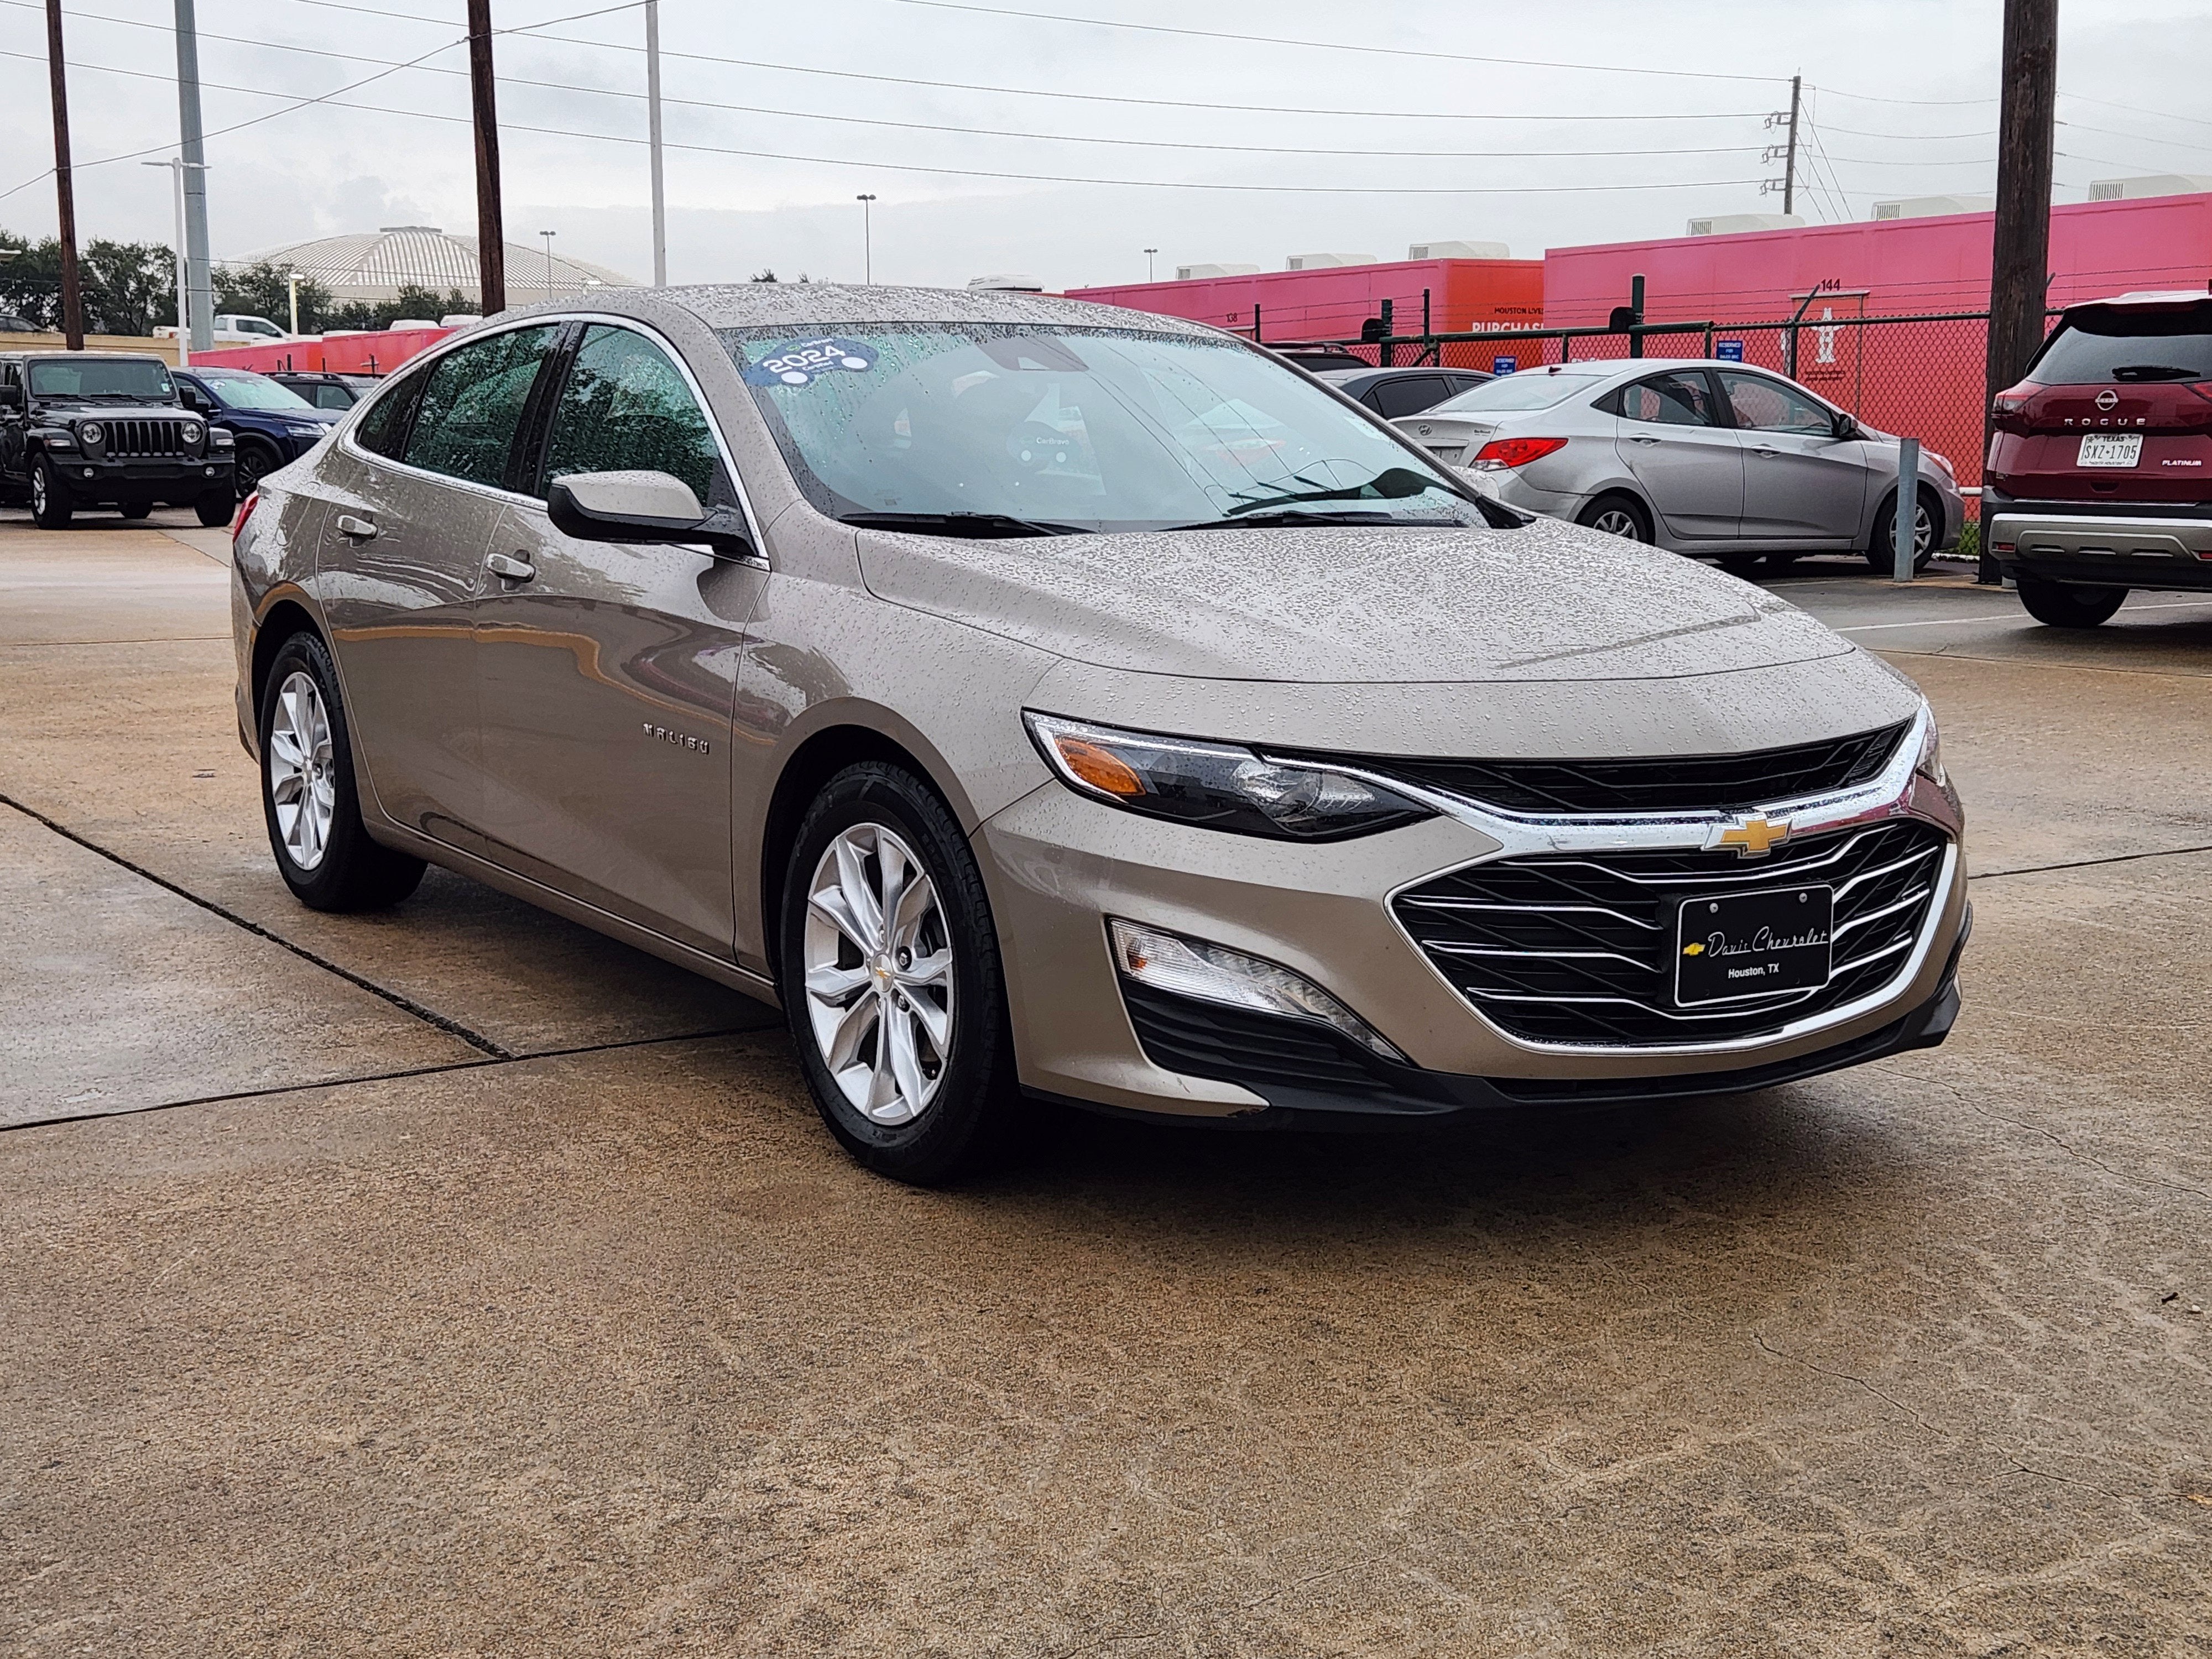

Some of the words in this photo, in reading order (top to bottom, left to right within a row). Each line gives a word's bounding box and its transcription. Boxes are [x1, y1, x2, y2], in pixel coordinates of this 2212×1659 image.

[1821, 278, 1840, 291] 144
[762, 345, 846, 373] 2024
[2064, 418, 2146, 426] ROGUE
[1036, 436, 1070, 446] CarBravo
[643, 723, 710, 755] MALIBU
[1708, 931, 1751, 957] Davis
[1752, 926, 1829, 952] Chevrolet
[1728, 966, 1766, 979] Houston,
[1767, 963, 1780, 974] TX
